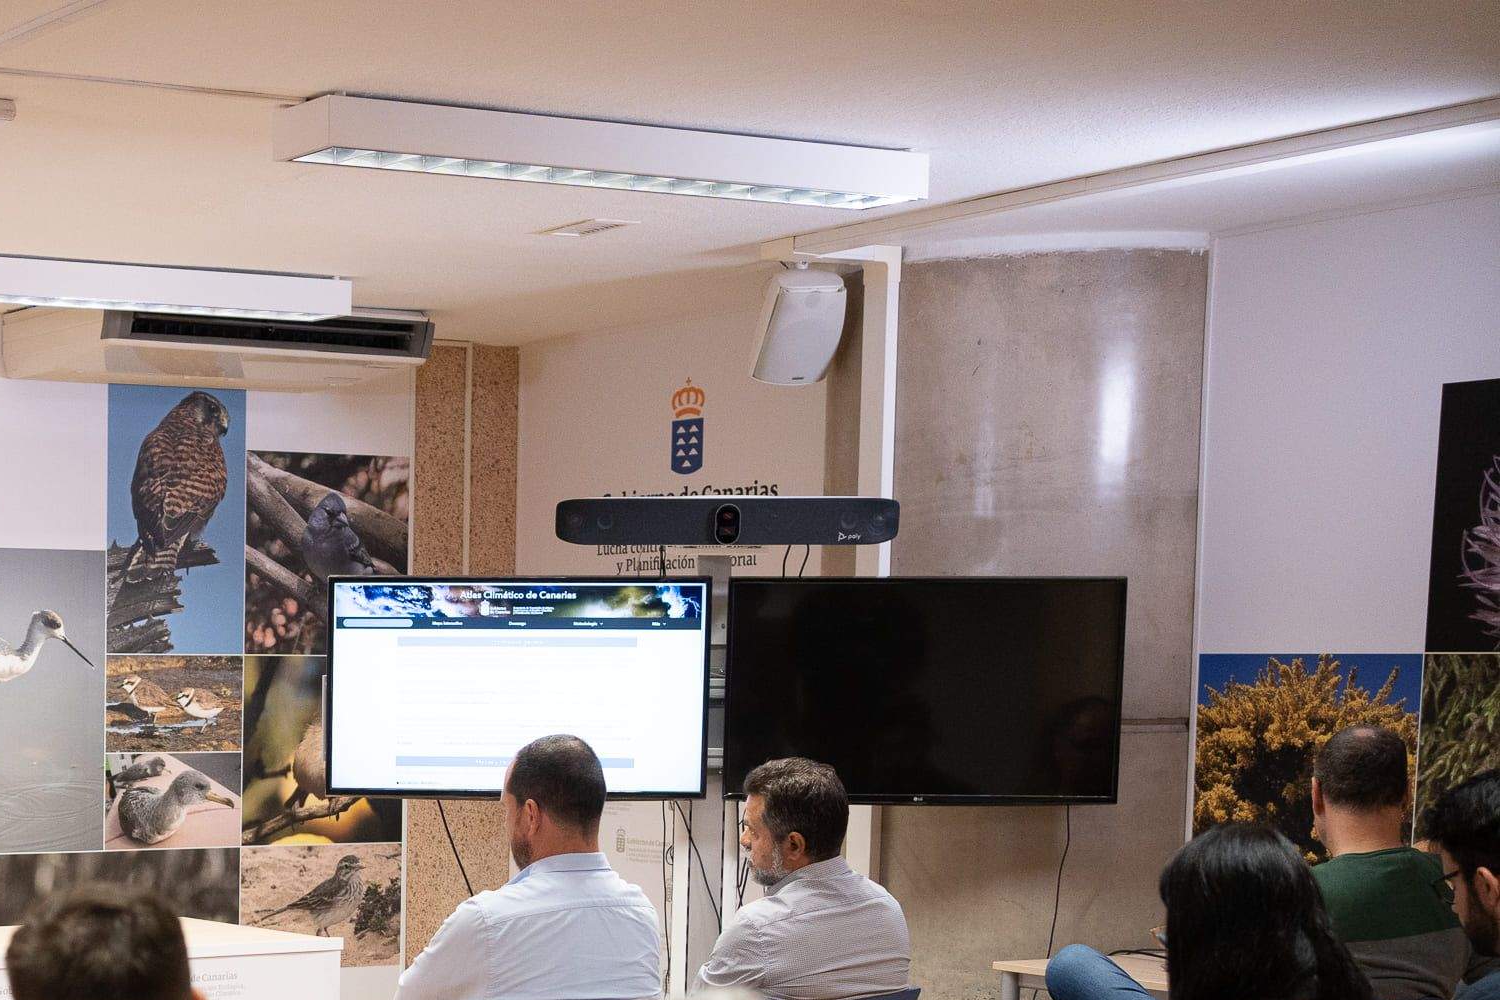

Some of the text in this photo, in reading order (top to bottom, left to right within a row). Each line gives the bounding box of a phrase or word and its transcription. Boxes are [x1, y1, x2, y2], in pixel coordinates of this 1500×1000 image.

[460, 590, 577, 600] Atlas Climático de Canarias
